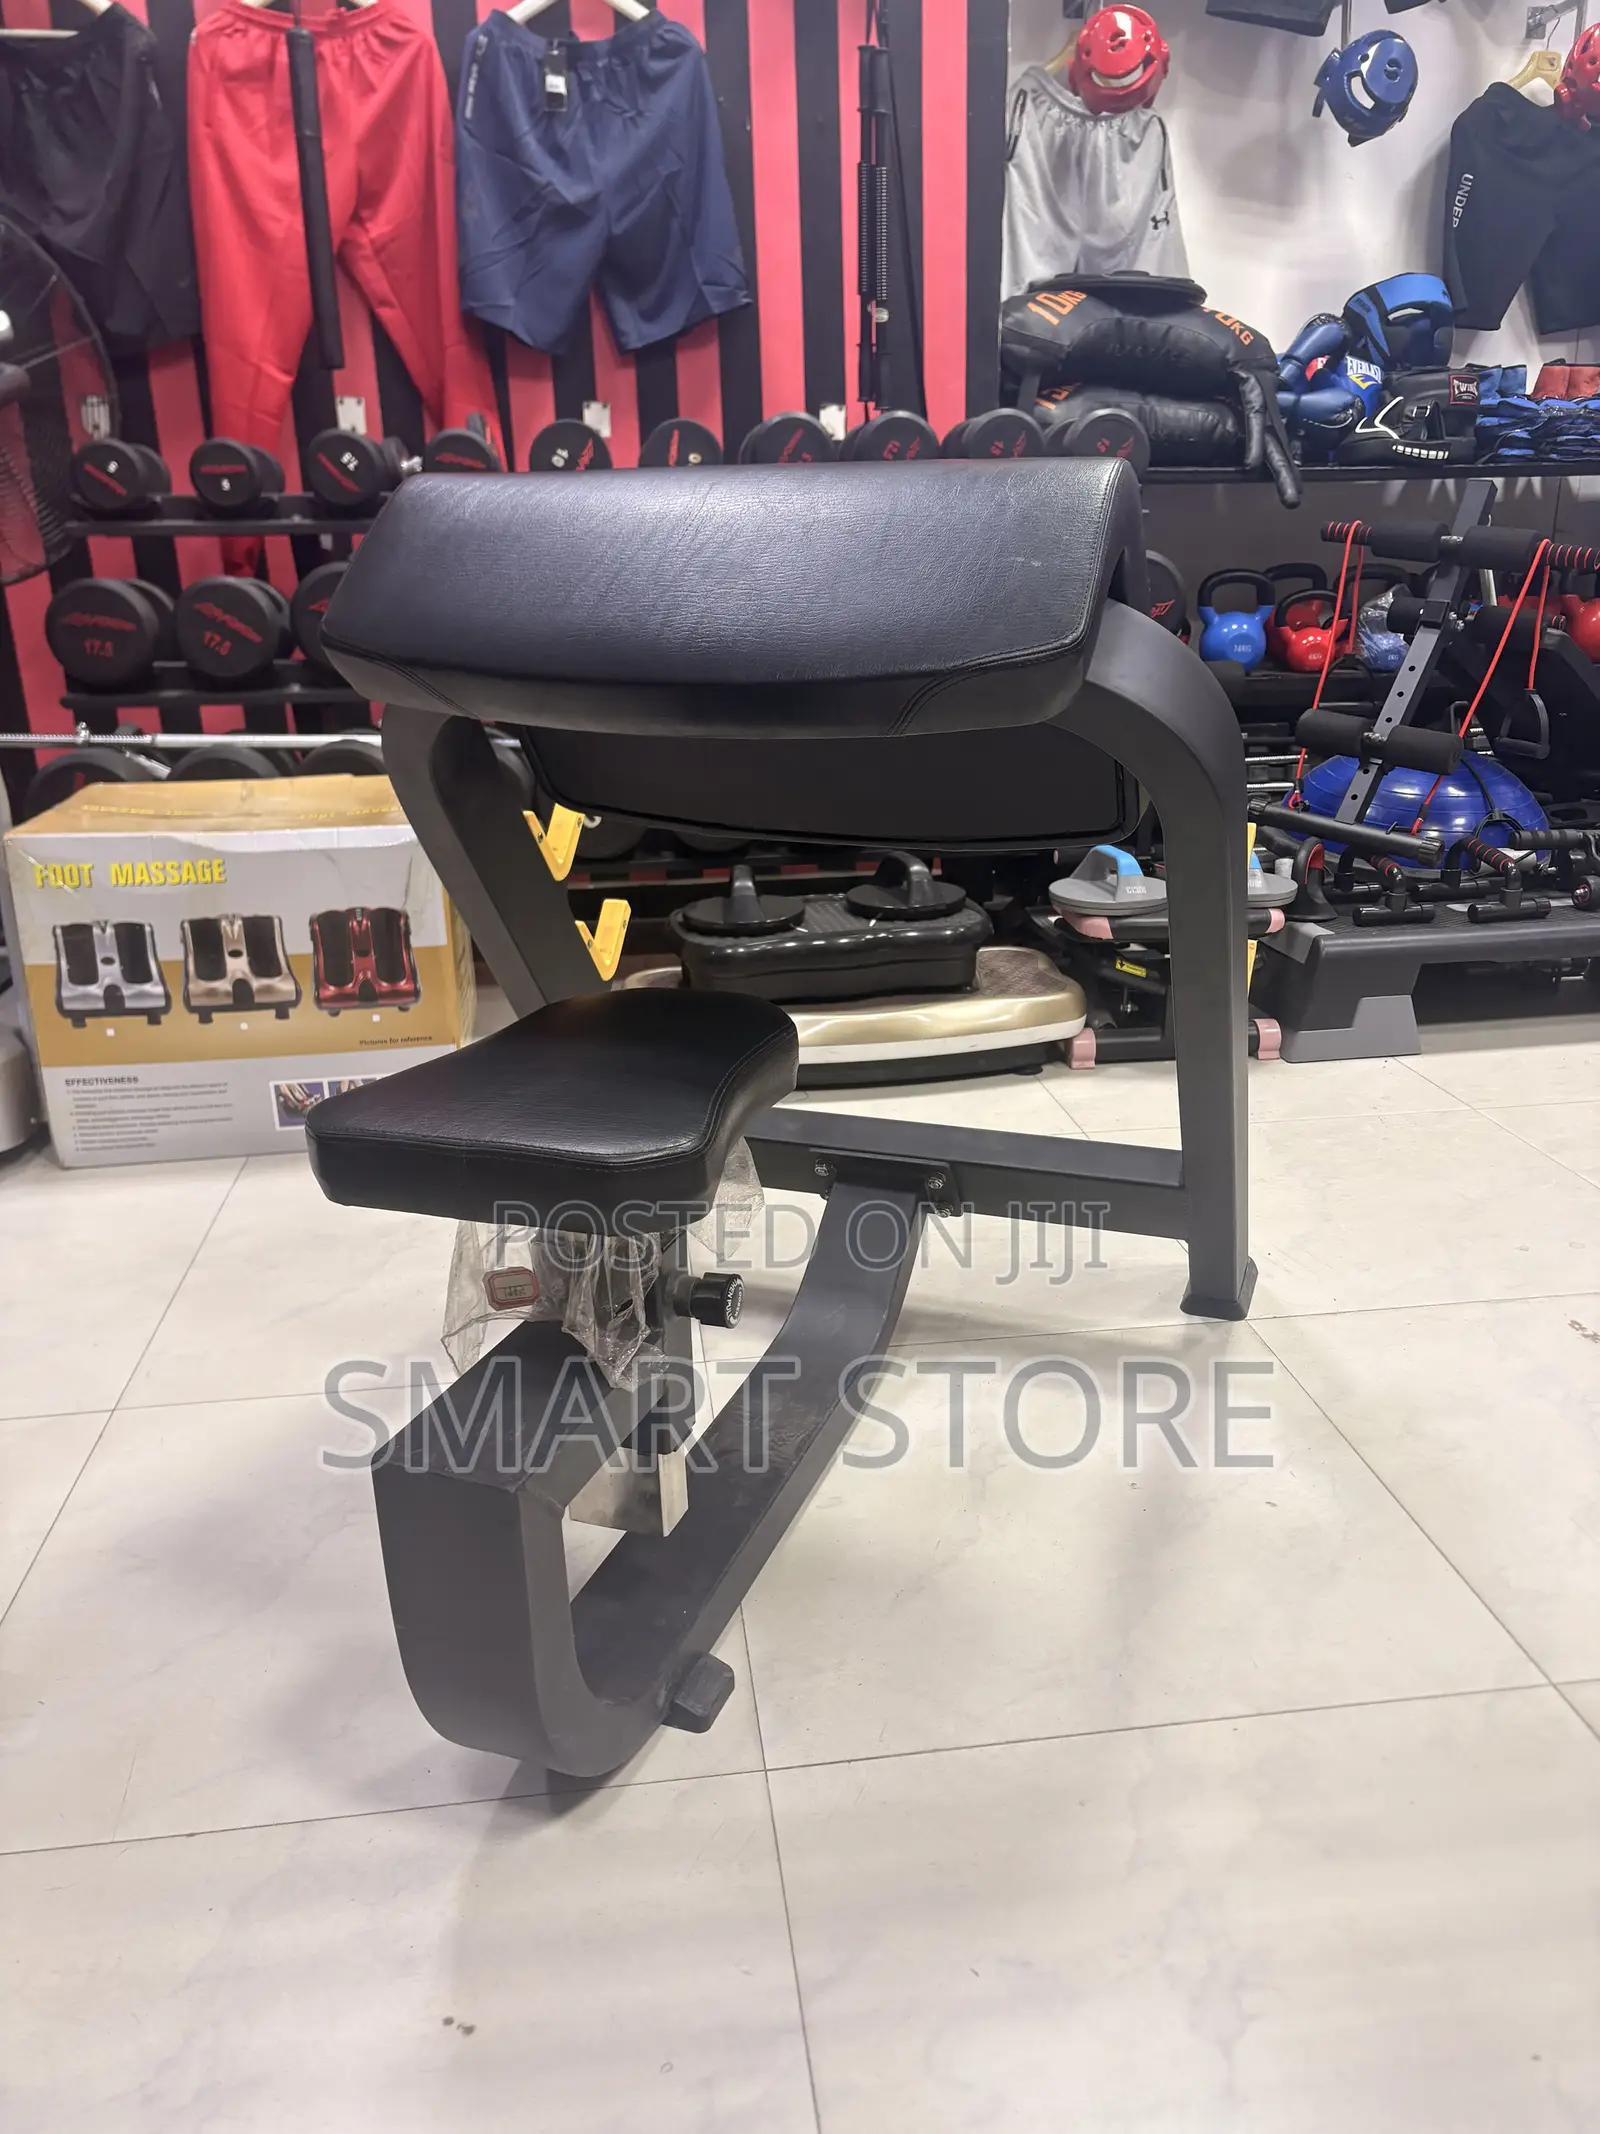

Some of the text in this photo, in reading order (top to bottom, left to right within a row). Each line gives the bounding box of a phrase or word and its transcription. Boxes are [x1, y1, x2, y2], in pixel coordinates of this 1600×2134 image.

[1203, 307, 1254, 346] 0KG
[34, 858, 227, 889] FOOT MASSAGE
[65, 1076, 139, 1087] EFFECTIVENESS
